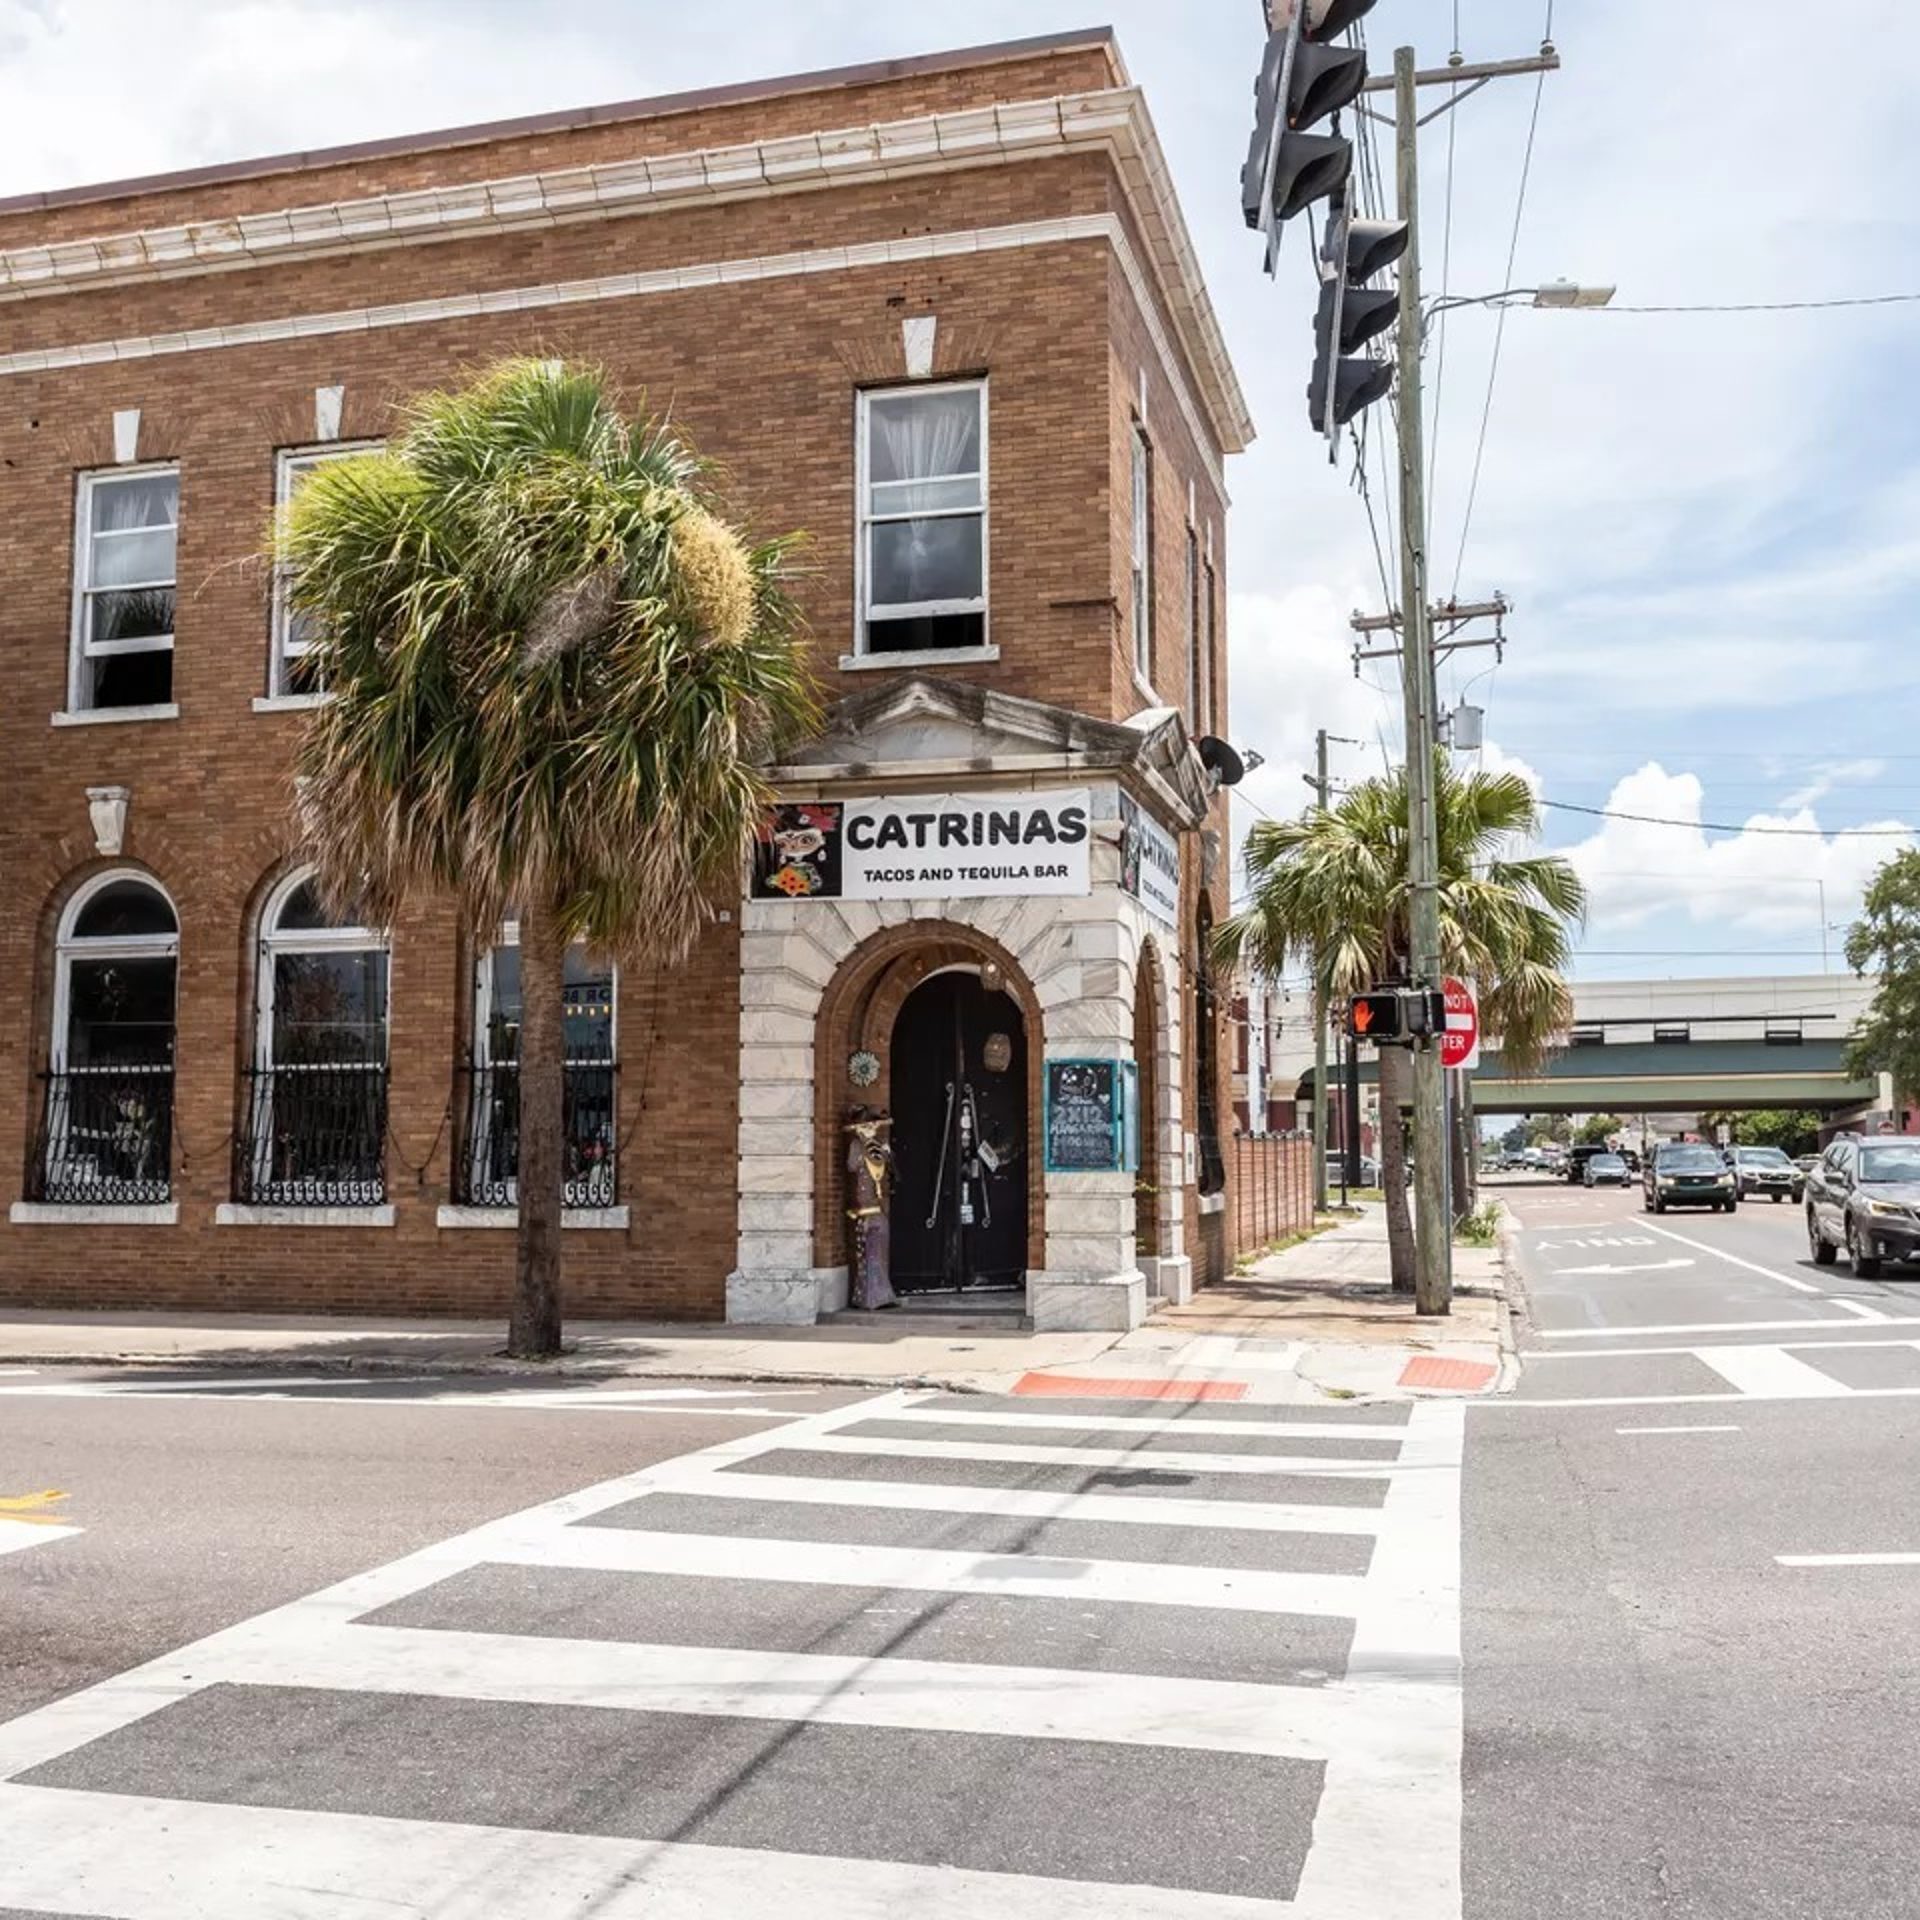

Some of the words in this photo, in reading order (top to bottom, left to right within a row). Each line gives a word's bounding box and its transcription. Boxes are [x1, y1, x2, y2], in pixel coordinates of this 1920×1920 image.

[846, 807, 1087, 850] CATRINAS
[864, 867, 915, 882] TACOS
[919, 867, 954, 881] AND
[958, 865, 1029, 881] TEQUILA
[1035, 864, 1068, 878] BAR
[1445, 995, 1468, 1009] NOT
[1441, 1035, 1465, 1050] TER
[1536, 1236, 1655, 1249] ONLY
